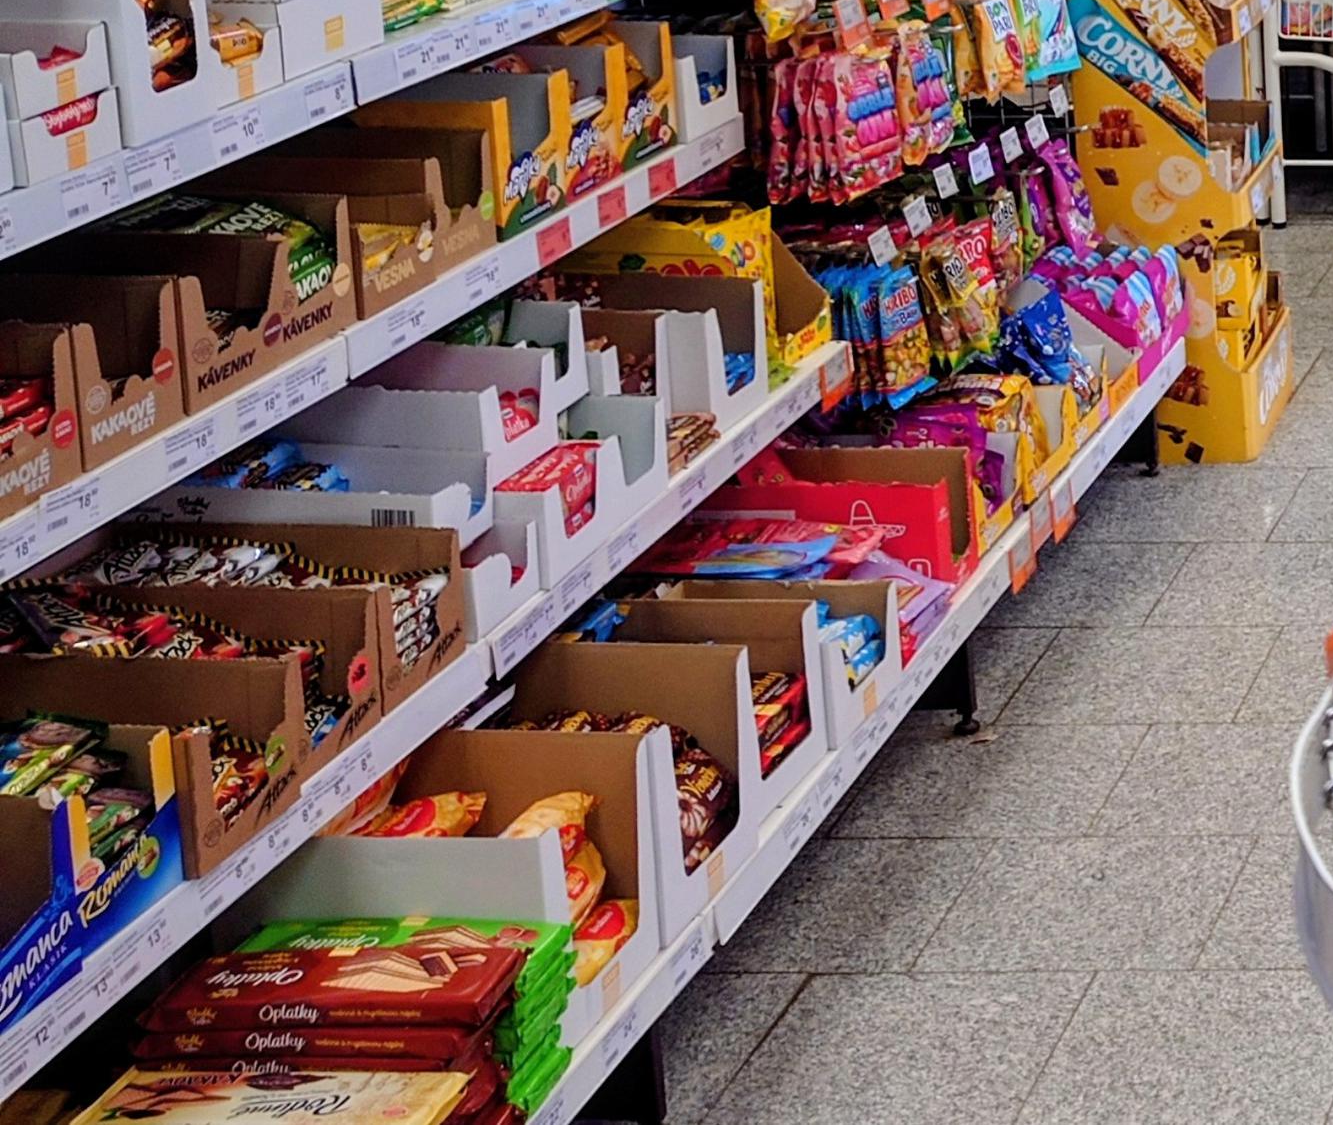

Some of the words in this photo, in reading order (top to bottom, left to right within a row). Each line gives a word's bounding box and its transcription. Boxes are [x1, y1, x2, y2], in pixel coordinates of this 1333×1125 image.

[1076, 15, 1176, 91] CORNY
[1085, 49, 1117, 74] BIG
[283, 301, 333, 343] KÁVENKY
[197, 349, 257, 394] KÁVENKY
[90, 391, 156, 445] KAKAOVÉ
[258, 1003, 320, 1024] Oplatky
[245, 1032, 306, 1052] Oplatky
